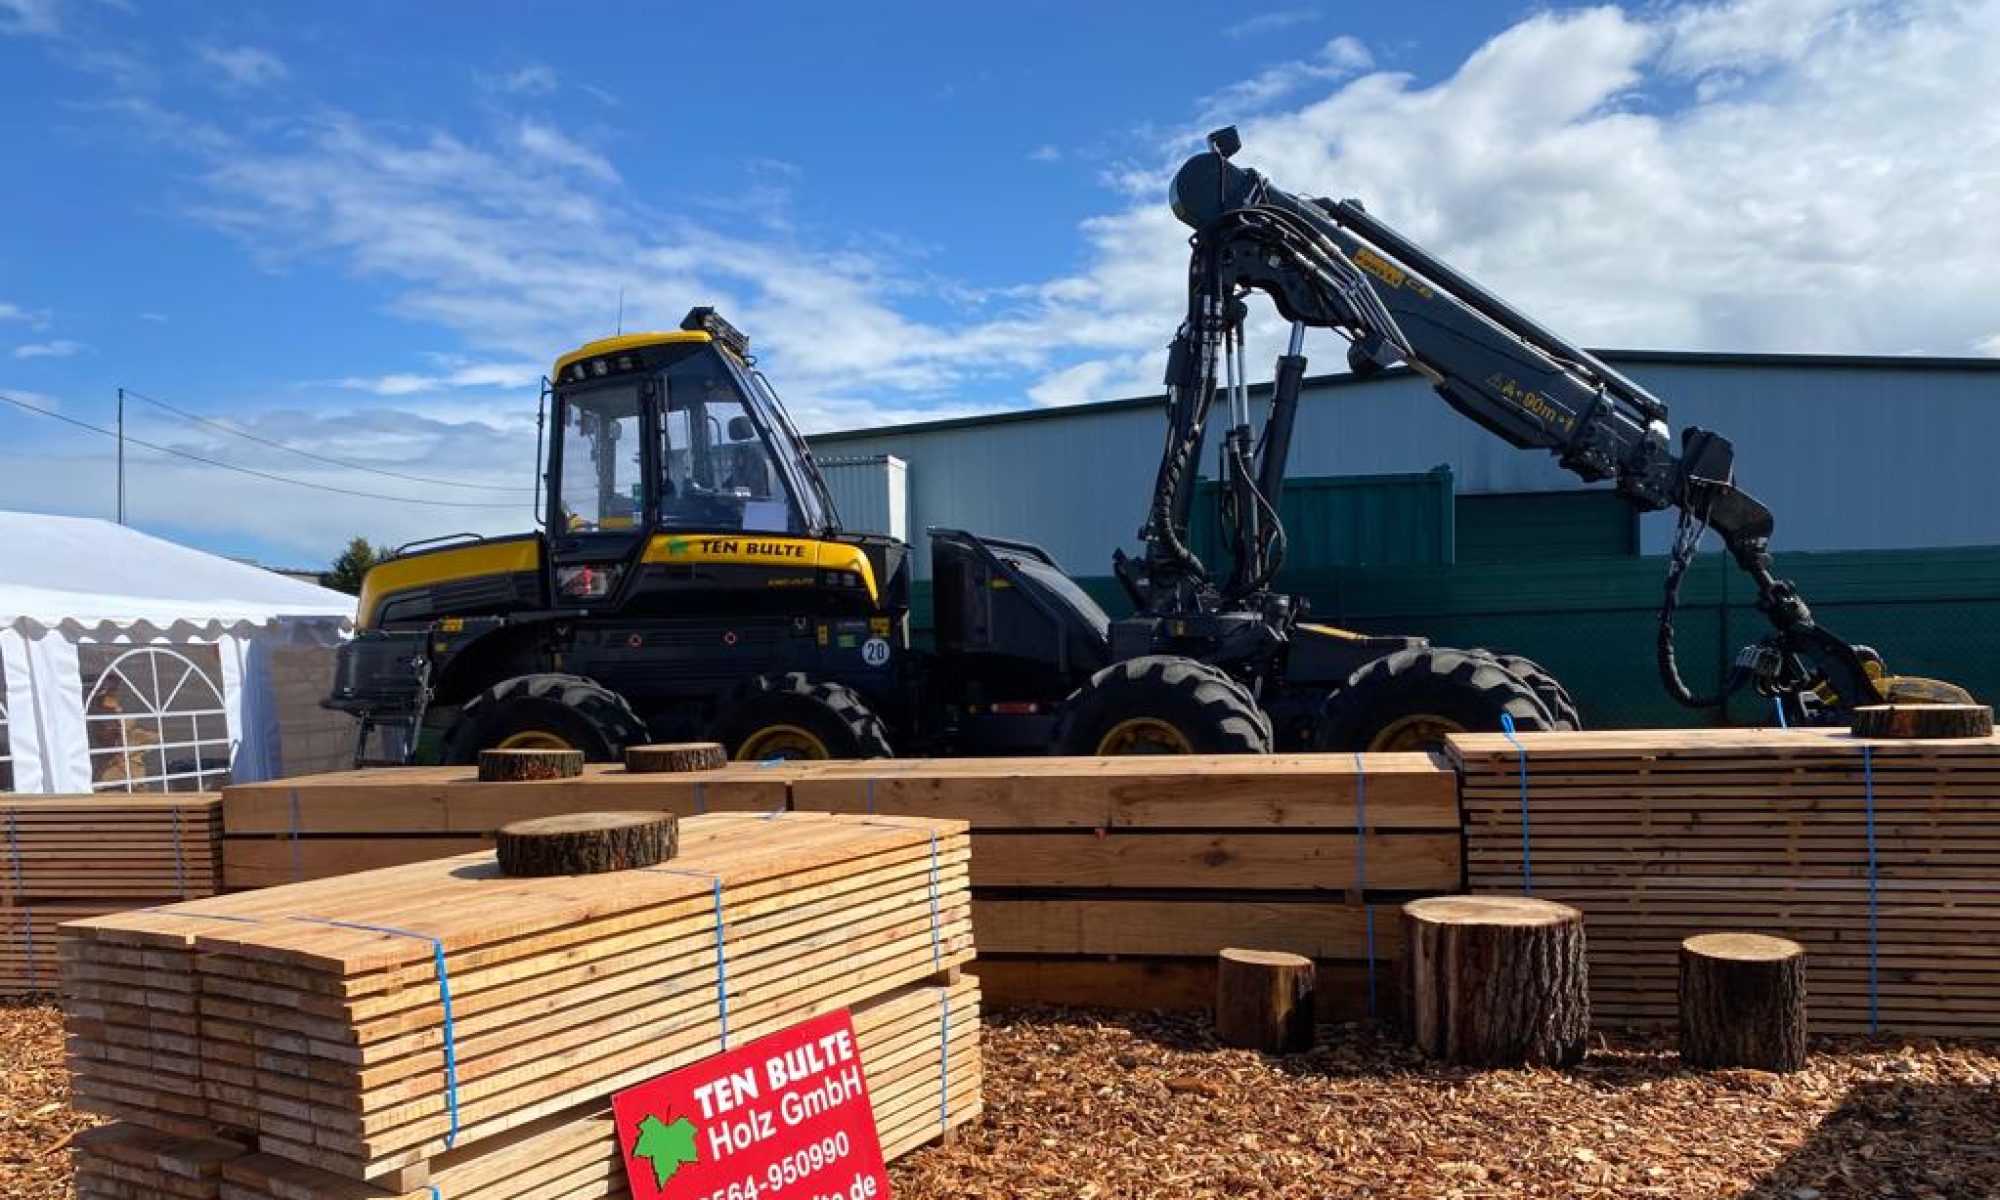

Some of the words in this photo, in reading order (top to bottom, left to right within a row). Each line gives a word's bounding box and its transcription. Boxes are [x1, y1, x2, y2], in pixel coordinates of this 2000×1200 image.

[701, 540, 738, 554] TEN
[746, 542, 805, 558] BULTE
[867, 642, 886, 660] 20
[693, 1066, 759, 1119] TEN
[765, 1029, 853, 1091] BULTE
[707, 1109, 777, 1161] Holz
[780, 1064, 863, 1126] GmbH
